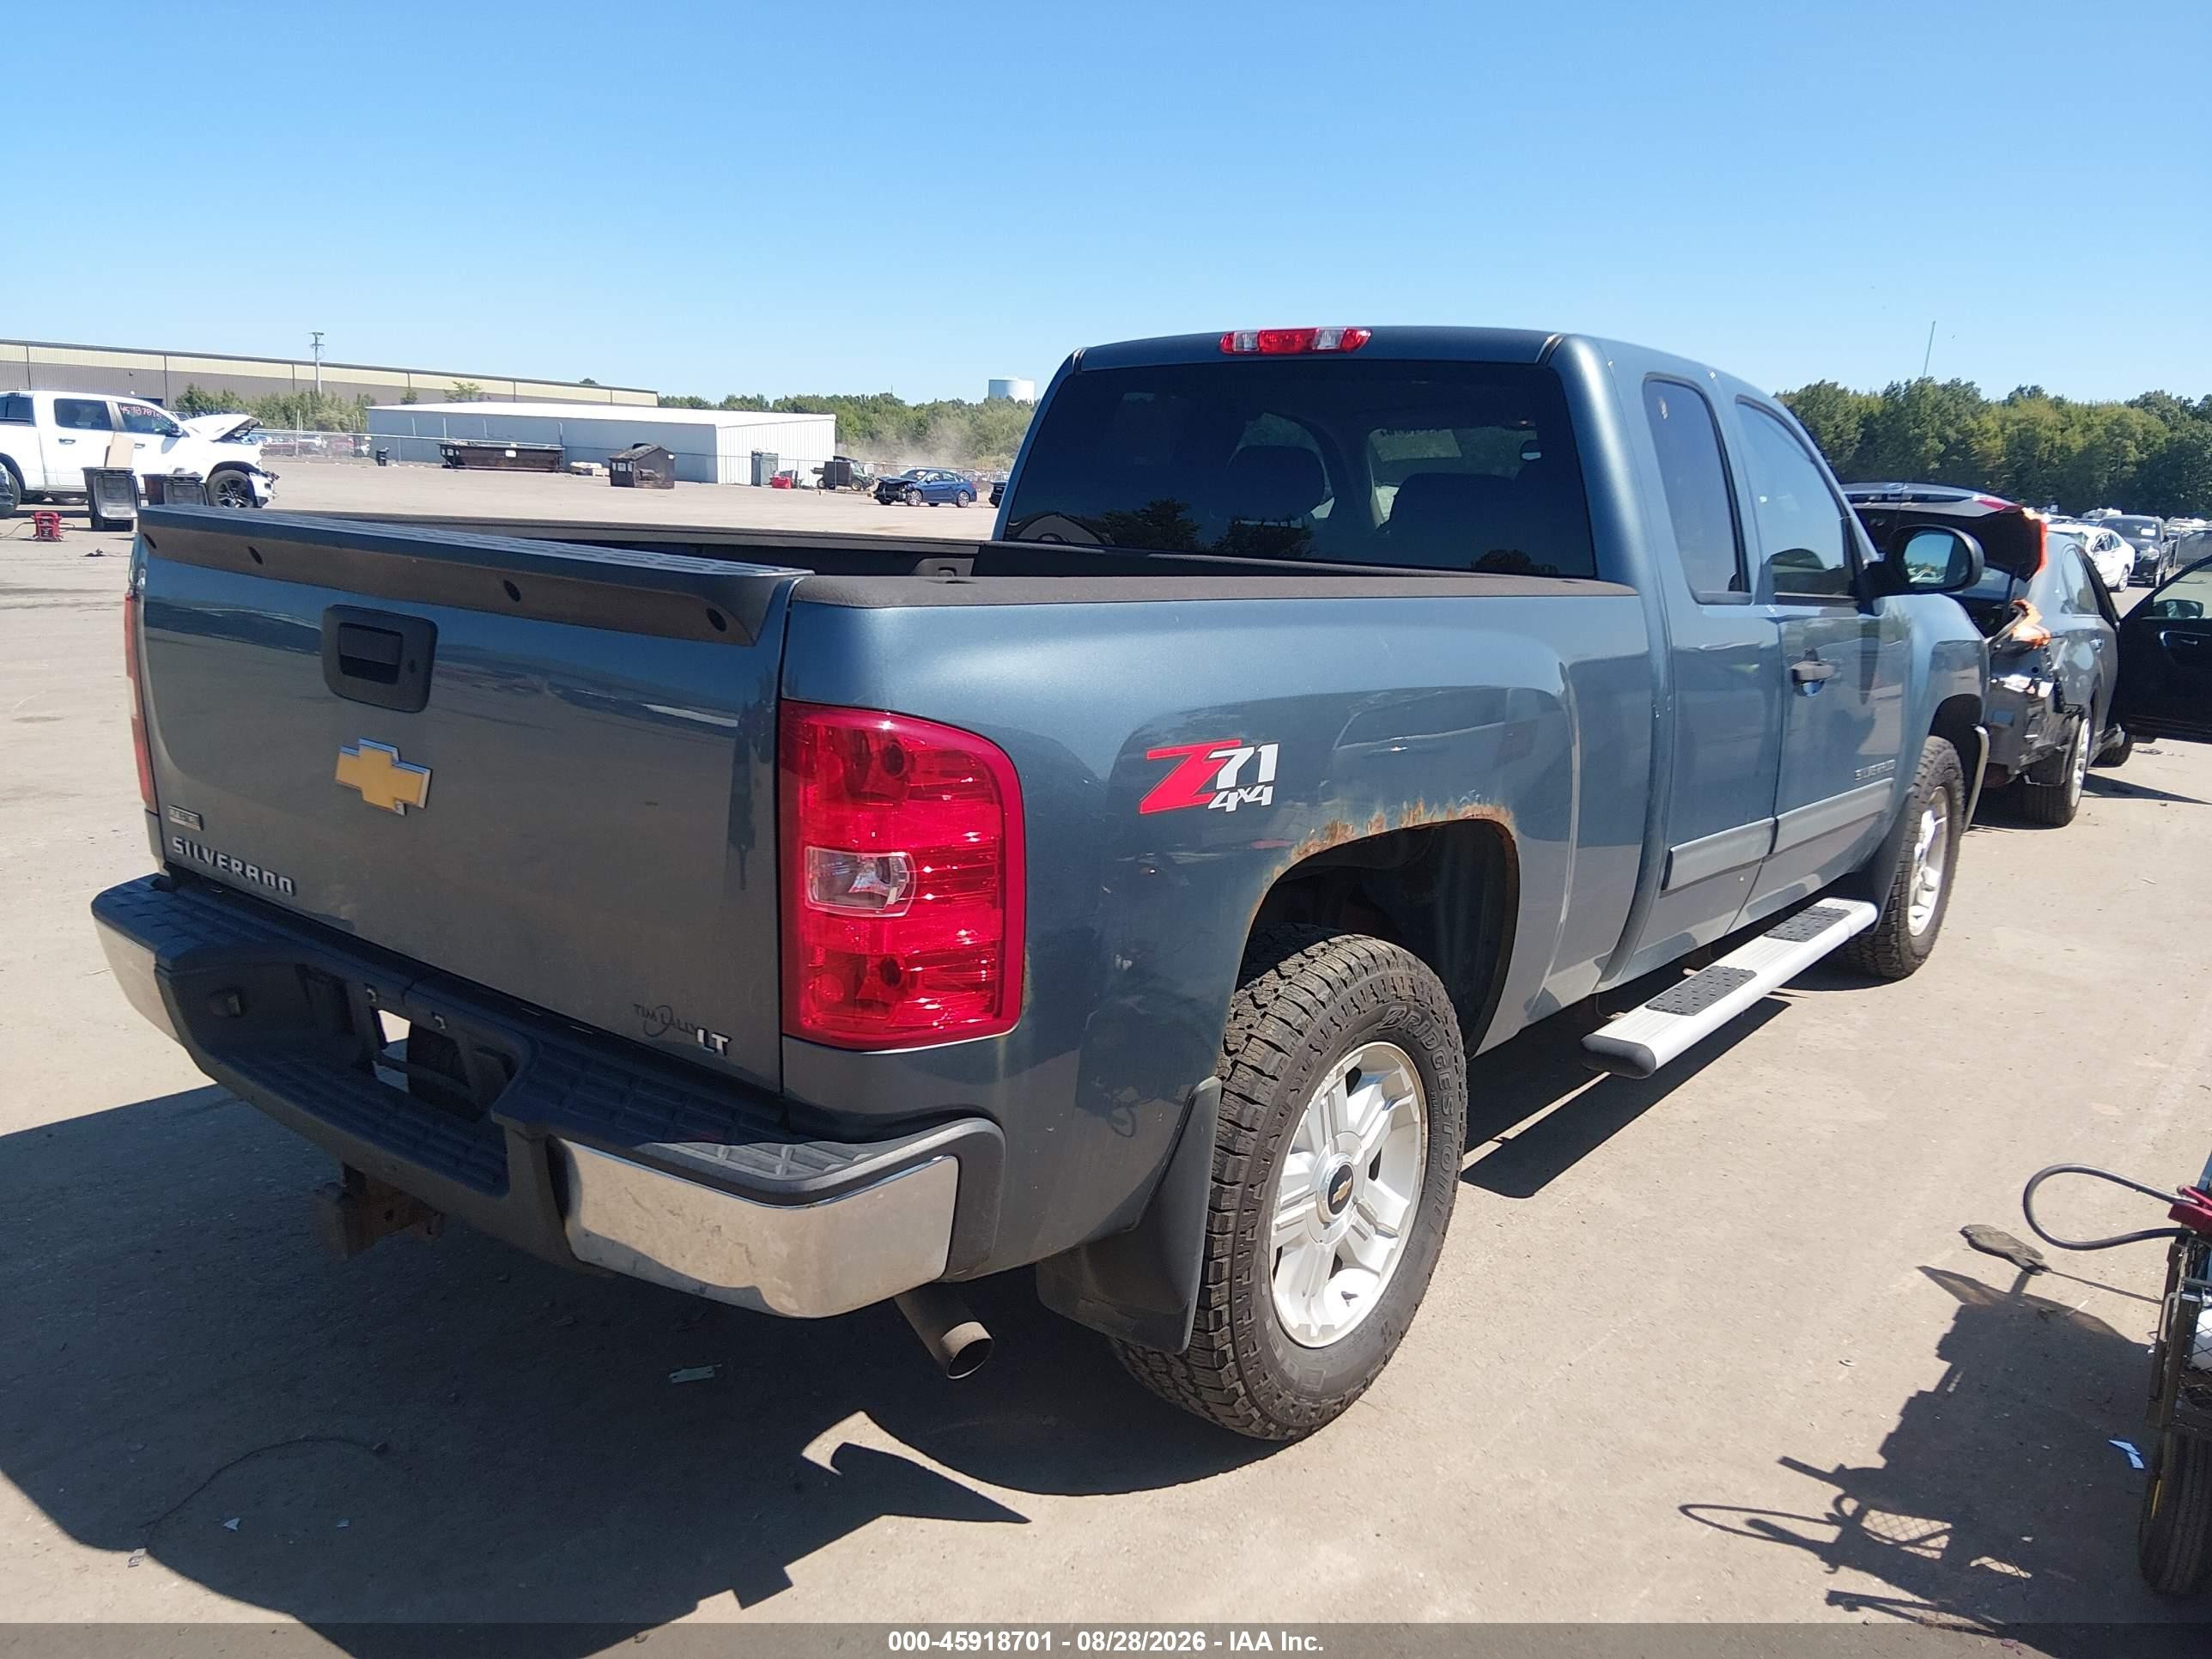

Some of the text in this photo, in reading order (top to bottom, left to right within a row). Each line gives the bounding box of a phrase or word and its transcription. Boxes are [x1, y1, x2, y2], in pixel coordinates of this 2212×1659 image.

[1139, 738, 1279, 815] Z71
[172, 836, 296, 897] SILVERADO
[633, 1003, 659, 1023] TIM
[696, 1027, 732, 1056] LT
